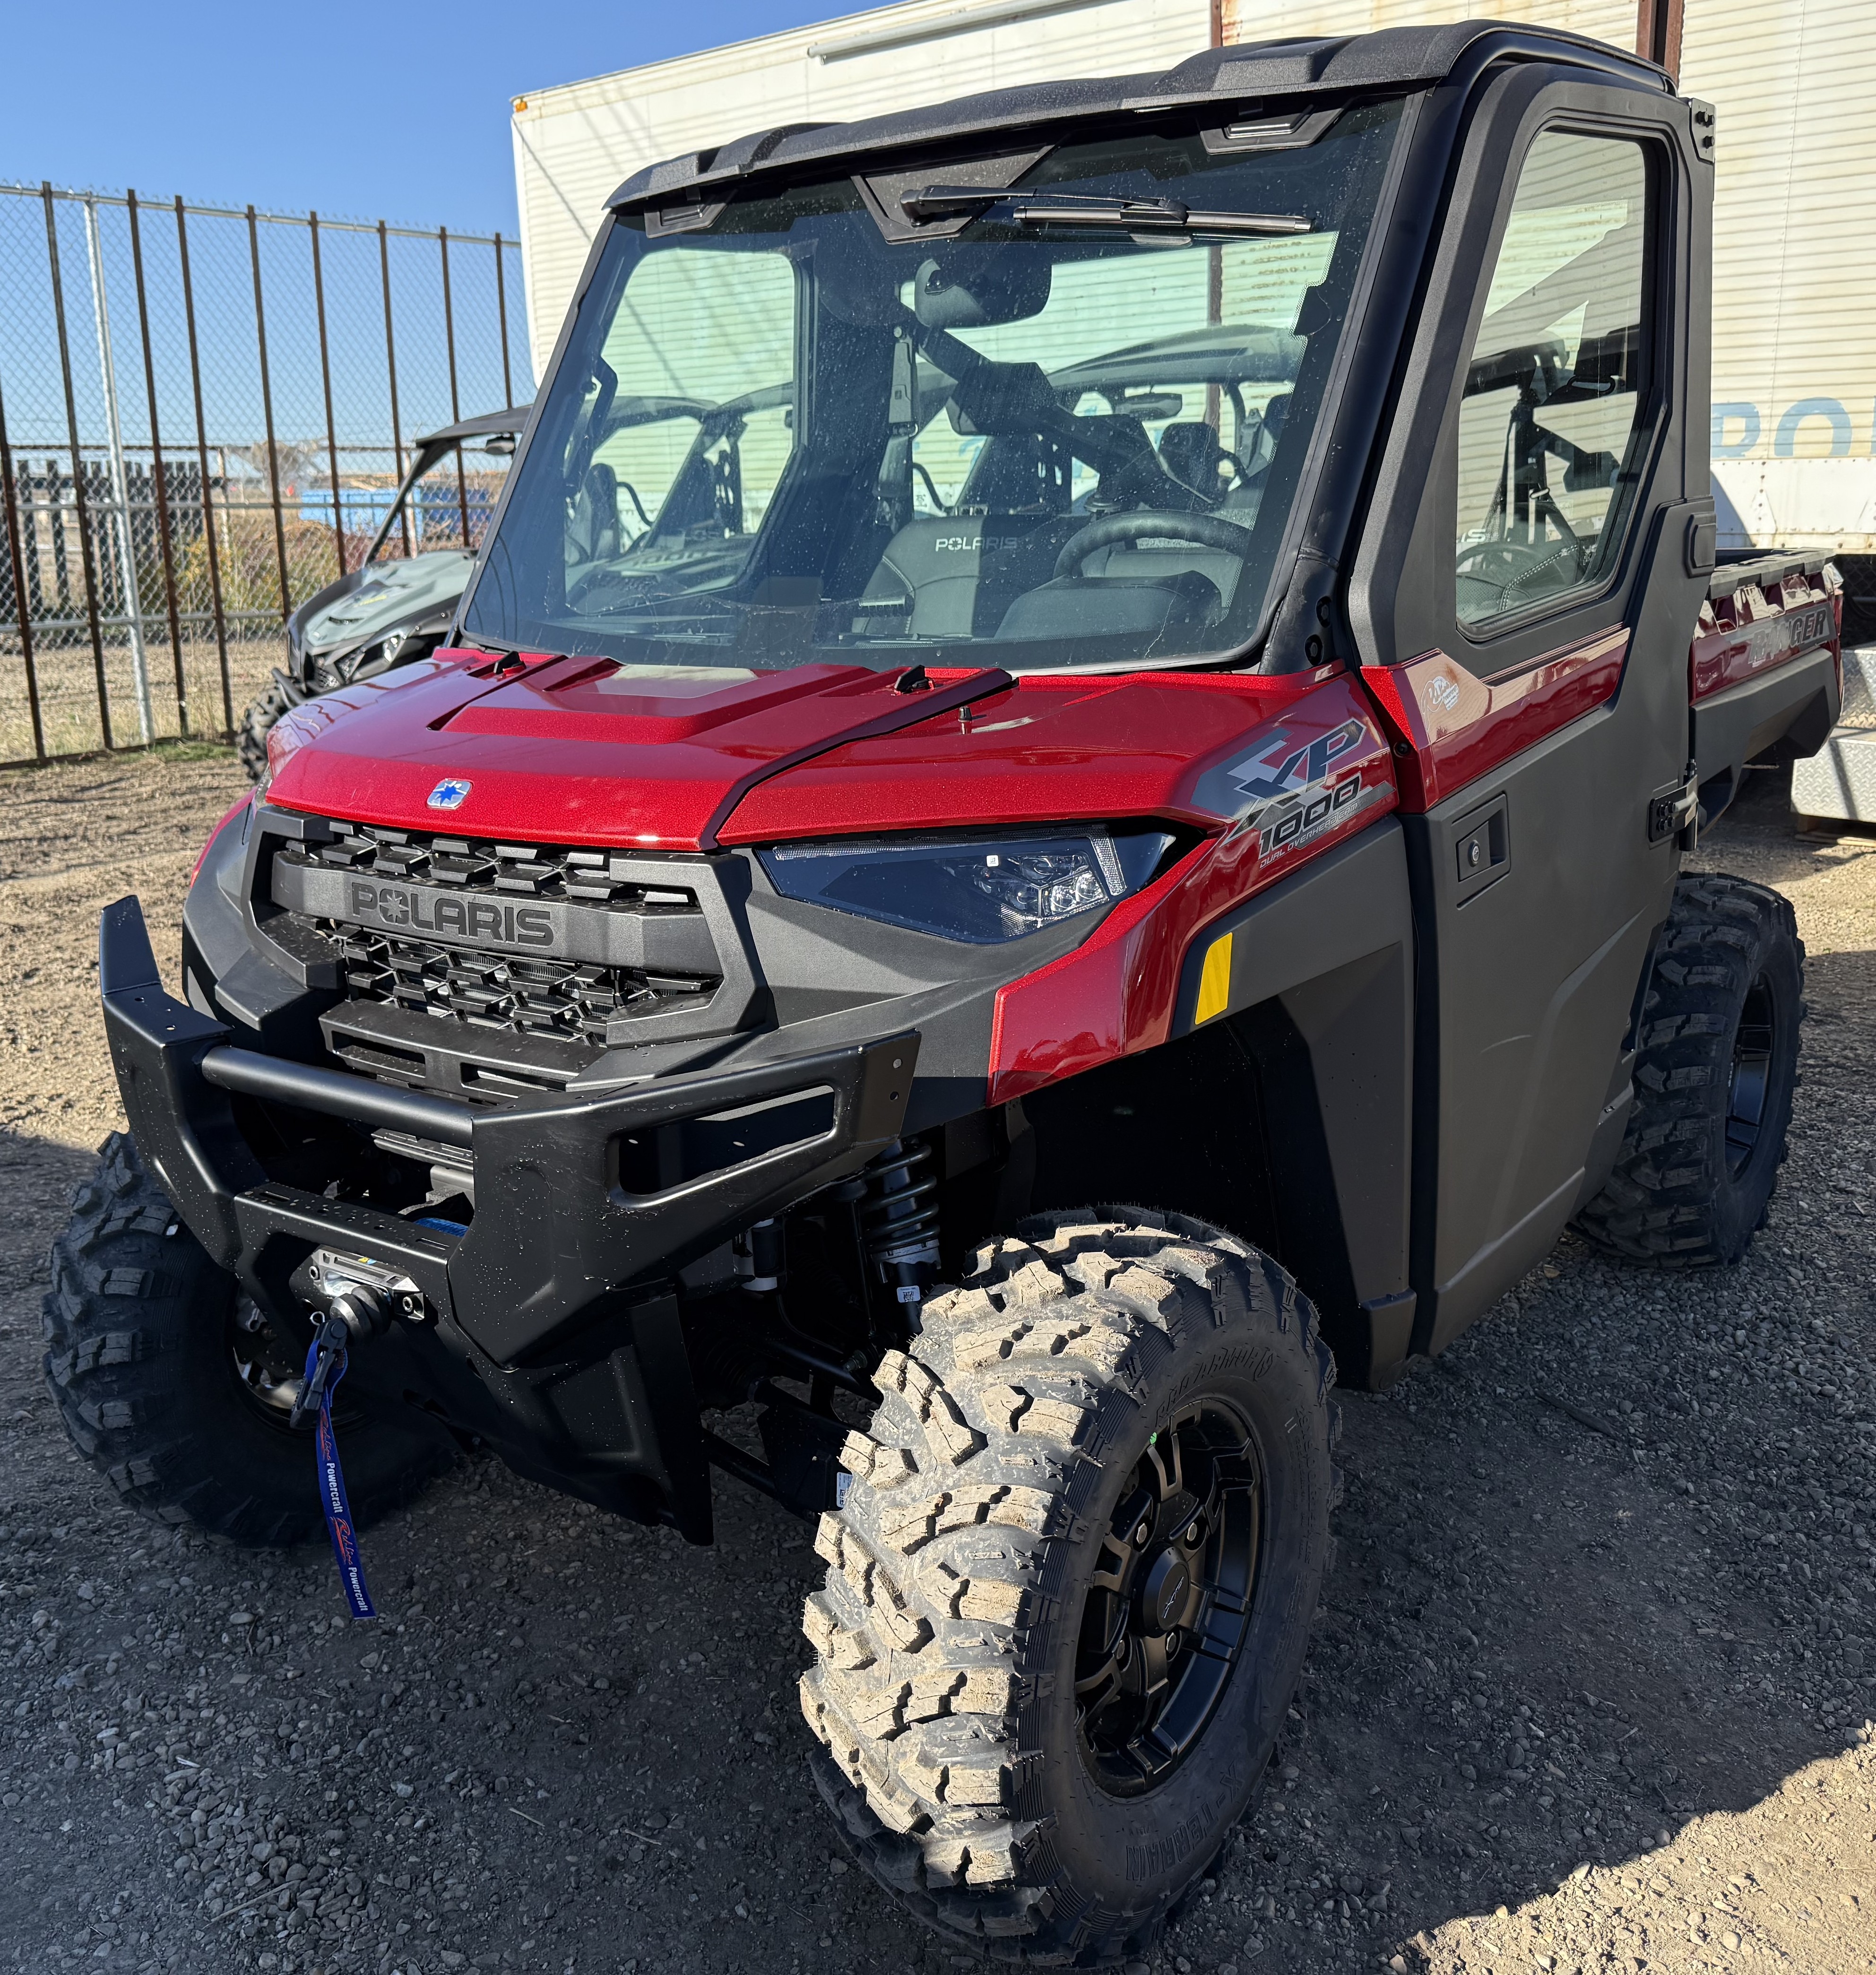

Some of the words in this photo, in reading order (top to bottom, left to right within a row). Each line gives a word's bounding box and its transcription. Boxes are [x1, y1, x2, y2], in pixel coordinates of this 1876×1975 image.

[935, 536, 1018, 552] POLARIS
[1748, 608, 1827, 664] RANGER
[1227, 717, 1367, 799] XP
[1258, 770, 1363, 860] 1000
[1260, 849, 1286, 869] DUAL
[1288, 813, 1339, 852] OVERHEAD
[352, 882, 554, 948] POLARIS
[327, 1463, 343, 1513] Powercraft
[348, 1567, 368, 1611] Powercraft
[1125, 1760, 1245, 1881] X-TERRAIN
